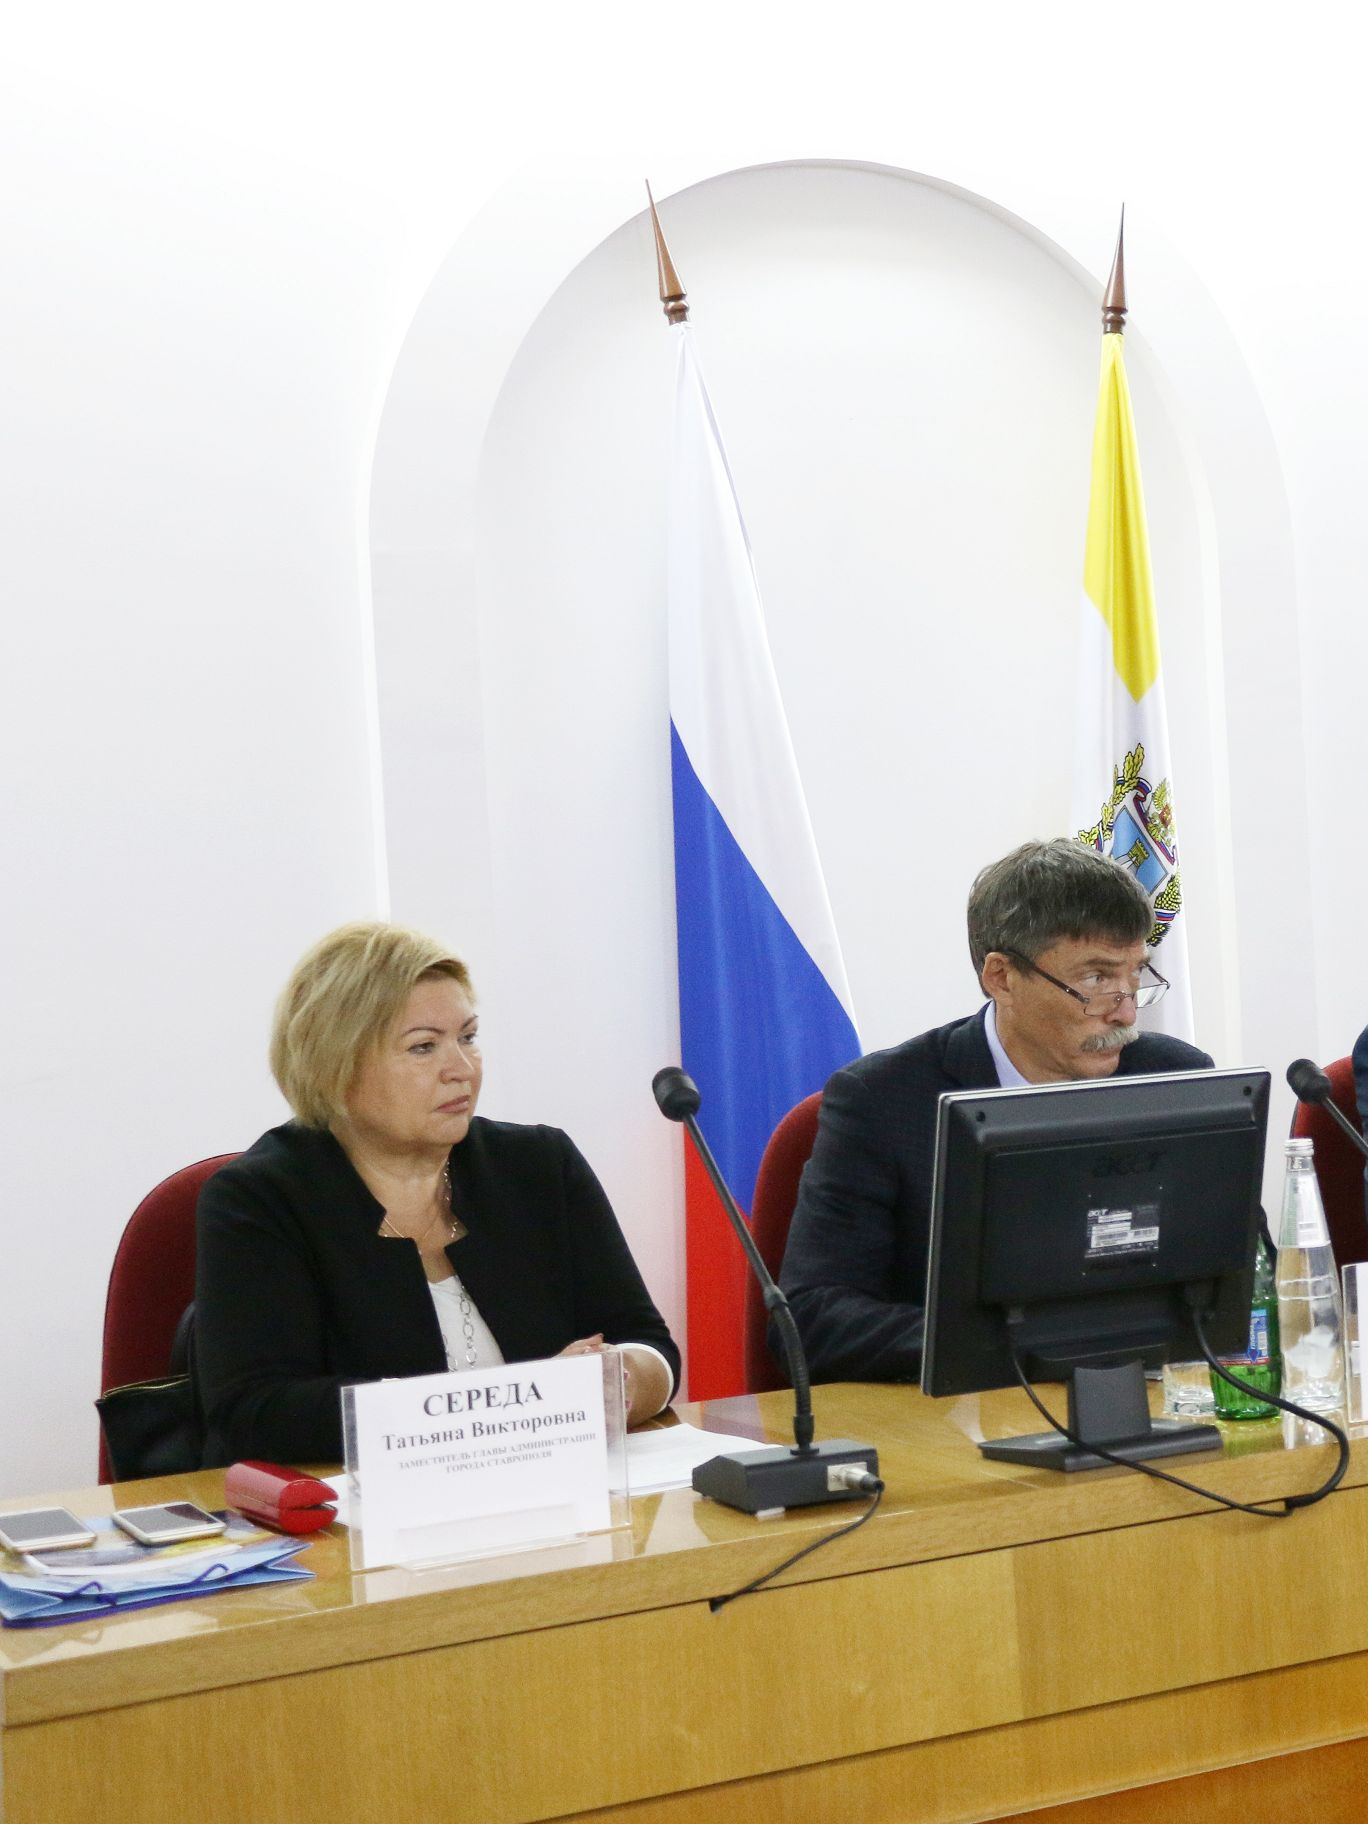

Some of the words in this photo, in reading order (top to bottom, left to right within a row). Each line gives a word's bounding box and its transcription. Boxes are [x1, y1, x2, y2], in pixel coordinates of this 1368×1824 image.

[423, 1381, 543, 1417] СЕРЕДА
[382, 1427, 464, 1451] Татьяна
[472, 1409, 587, 1439] Викторовна
[399, 1453, 471, 1470] ЗАМЕСТИТЕЛЬ
[473, 1446, 507, 1458] ГЛАВЫ
[510, 1433, 597, 1453] АДМИНИСТРАЦИИ
[446, 1461, 486, 1473] ГОРОДА
[487, 1451, 553, 1468] СТАВРОПОЛЯ
